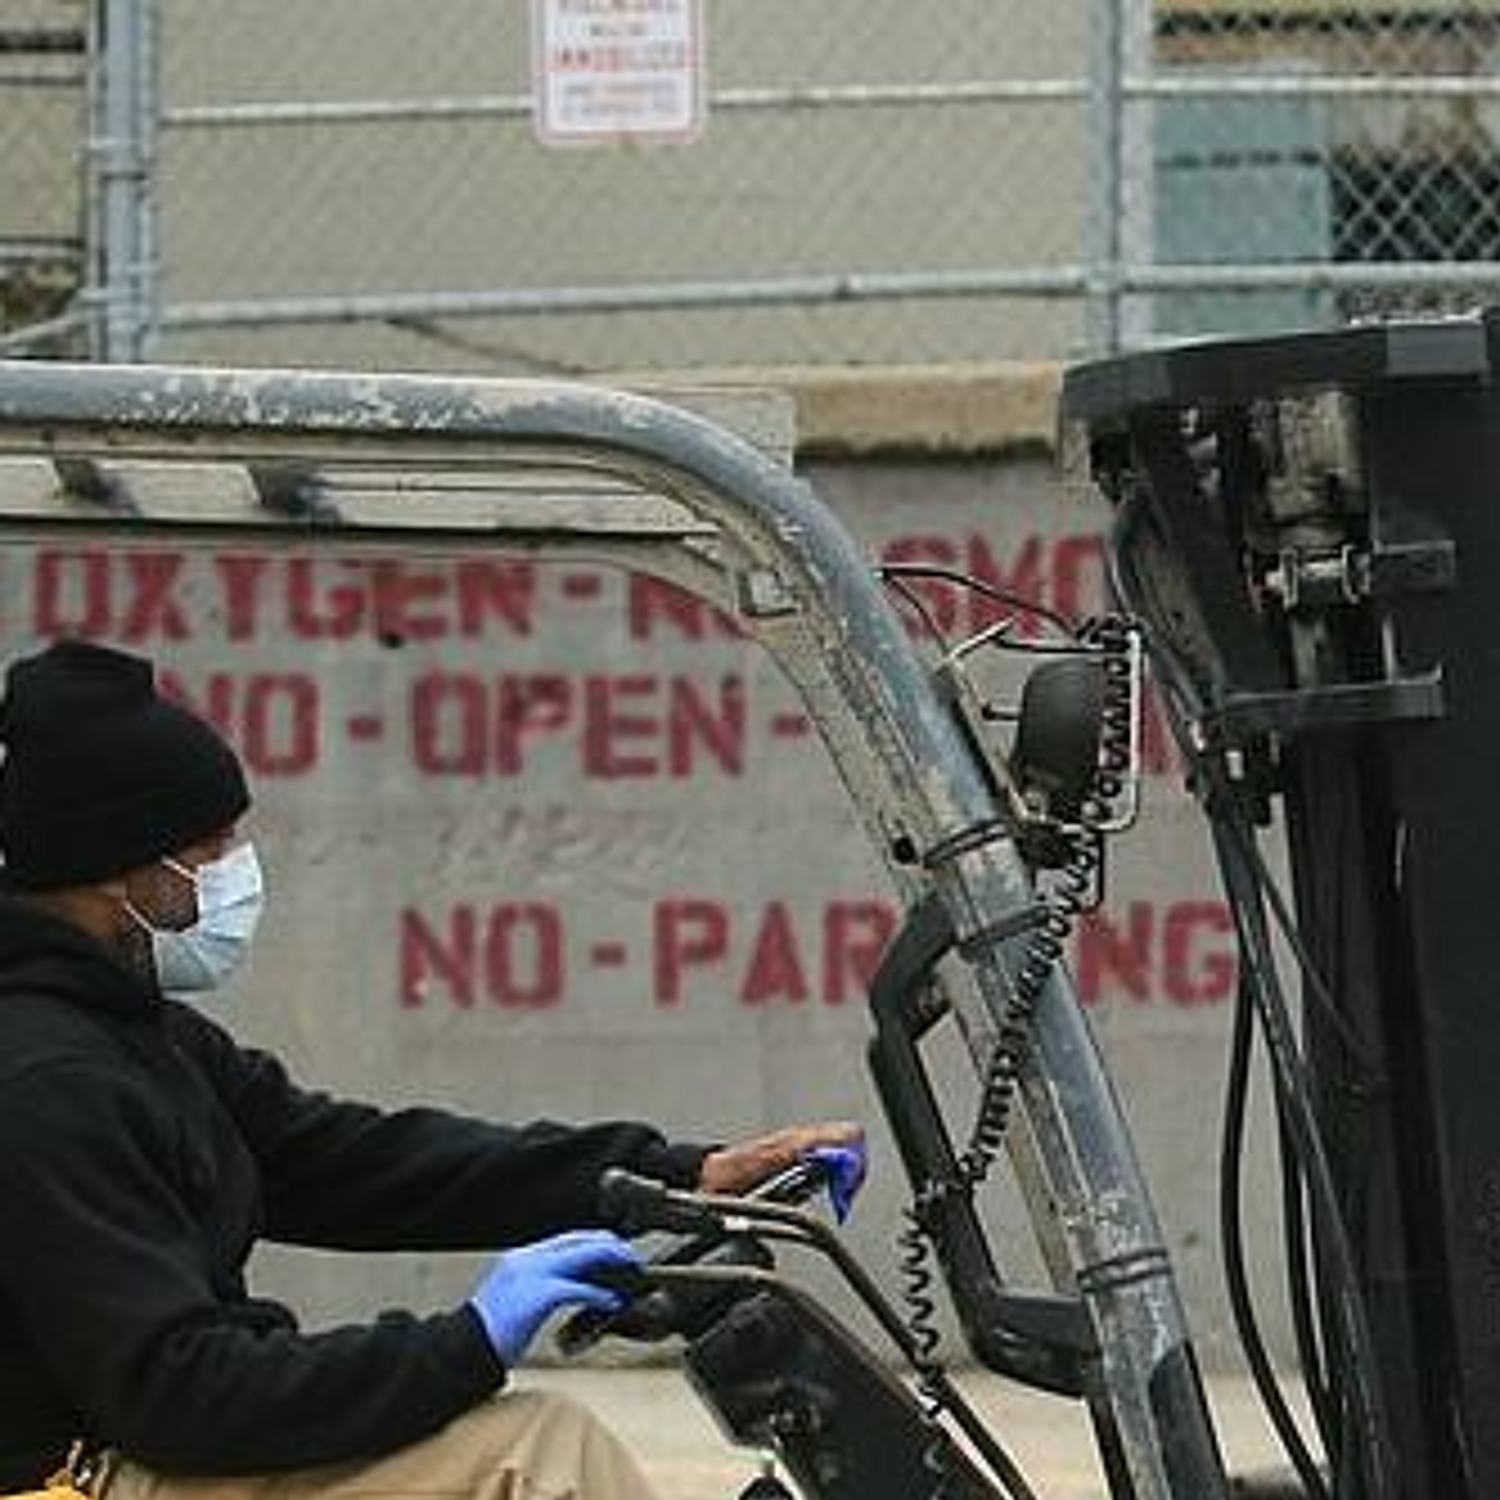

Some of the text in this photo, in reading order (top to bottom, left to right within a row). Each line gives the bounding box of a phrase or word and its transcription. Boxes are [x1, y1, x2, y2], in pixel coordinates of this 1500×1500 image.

[34, 552, 533, 641] OXYGEN
[414, 674, 746, 780] OPEN
[402, 903, 563, 1006] NO
[654, 902, 1238, 1008] PARNG
